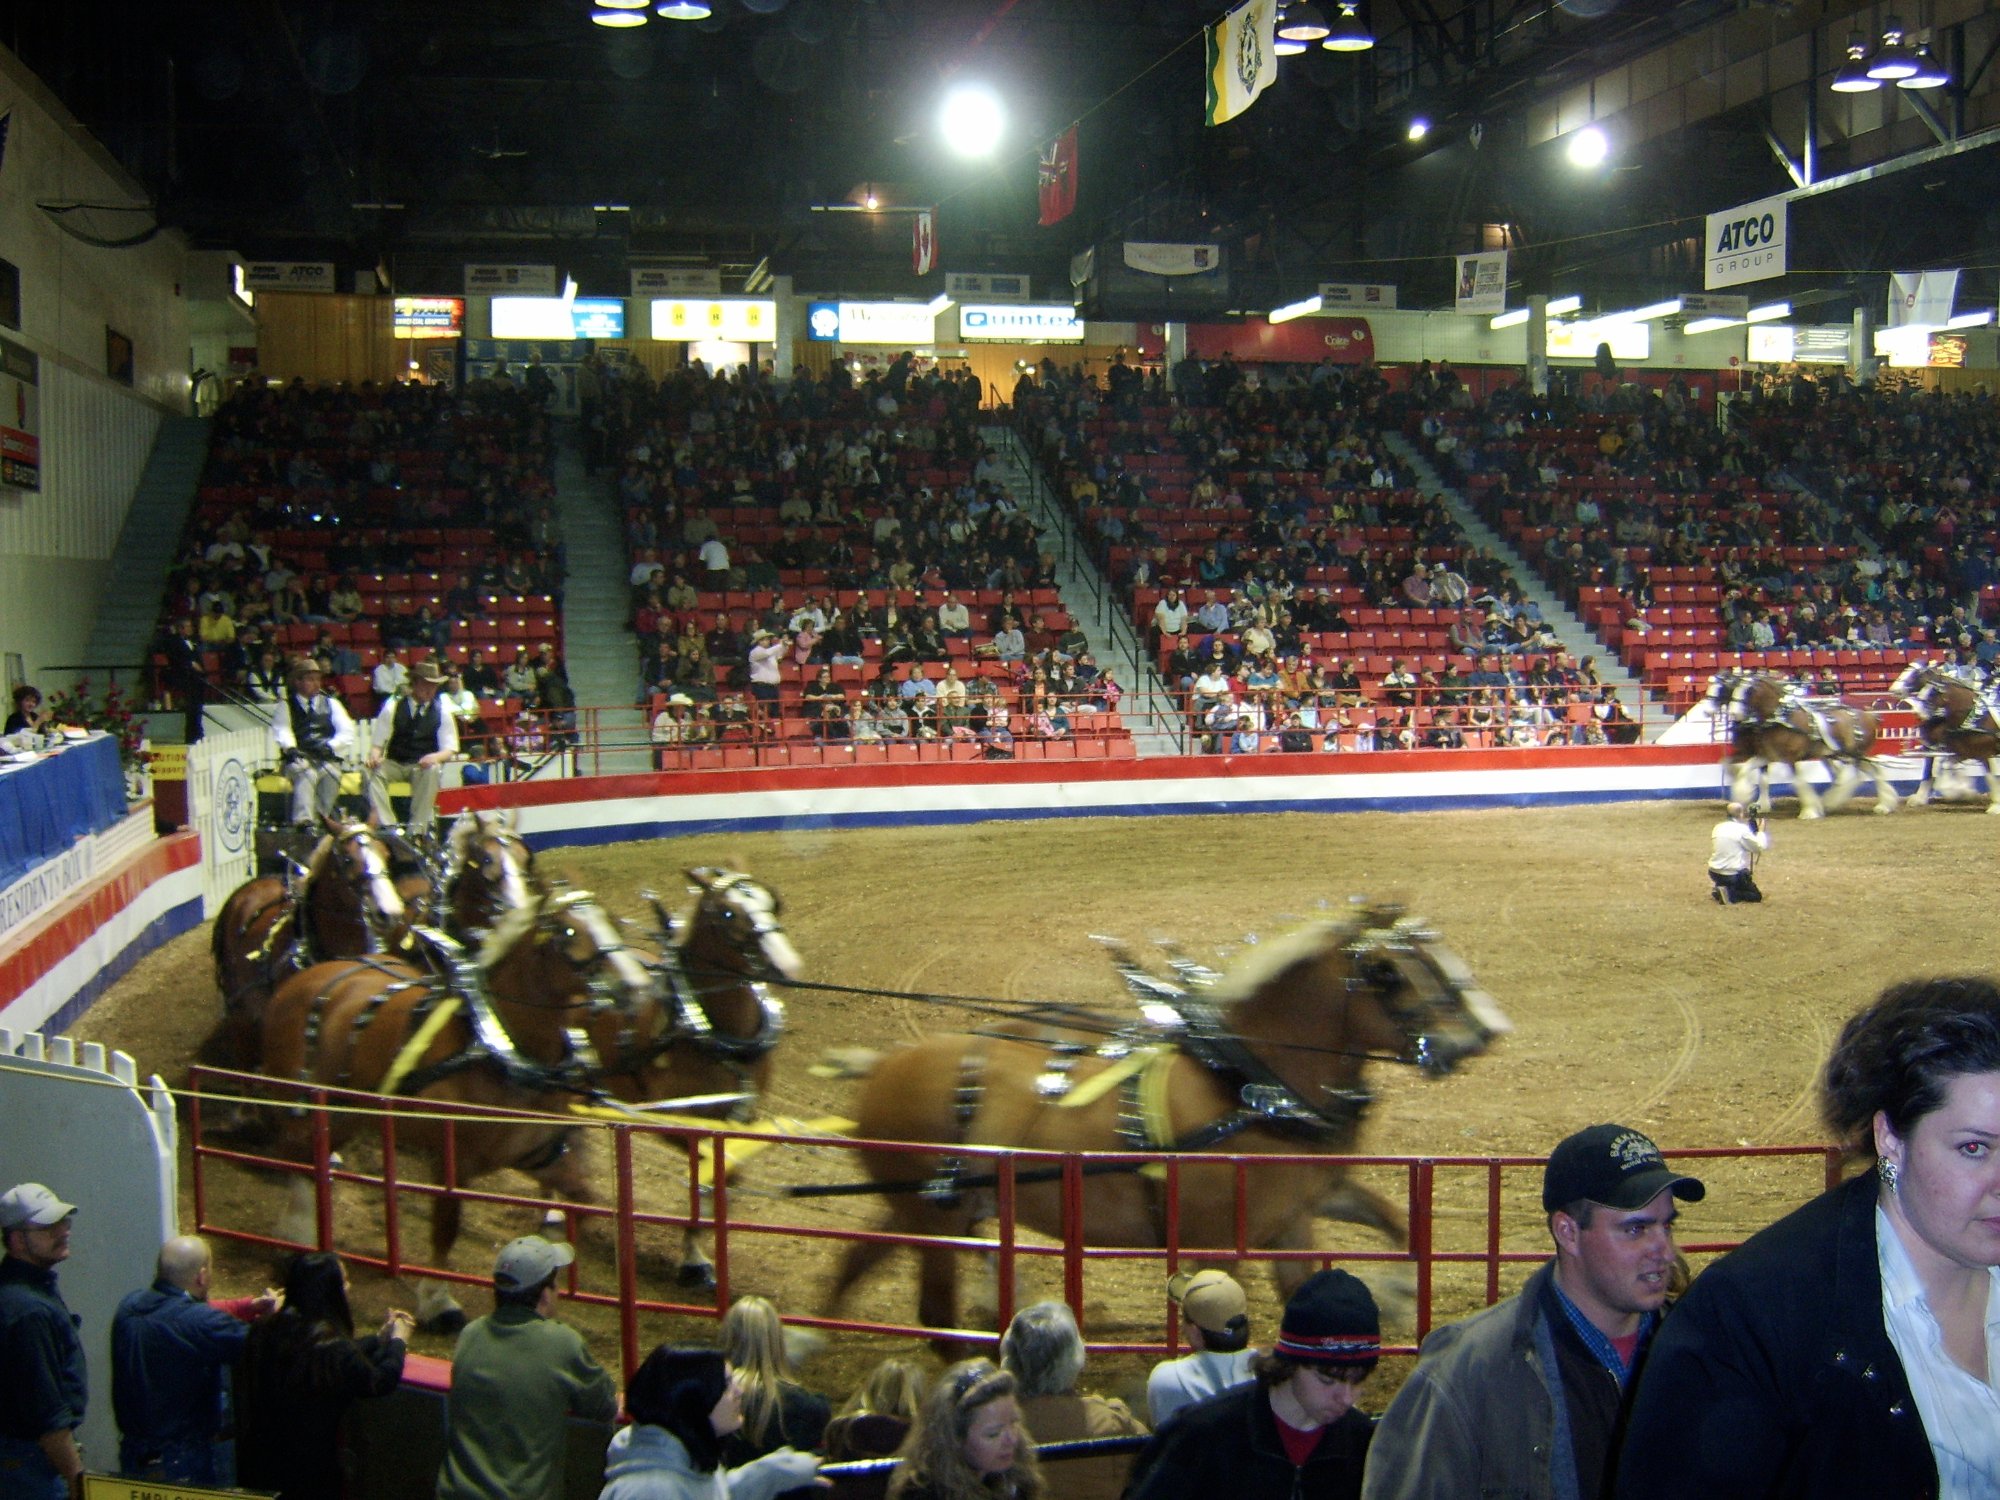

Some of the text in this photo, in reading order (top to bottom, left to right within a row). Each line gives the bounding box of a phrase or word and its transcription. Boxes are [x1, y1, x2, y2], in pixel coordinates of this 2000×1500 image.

[1716, 212, 1775, 254] ATCO
[290, 265, 324, 276] ATCO
[1715, 252, 1774, 274] GROUP
[966, 312, 1078, 327] Quintex
